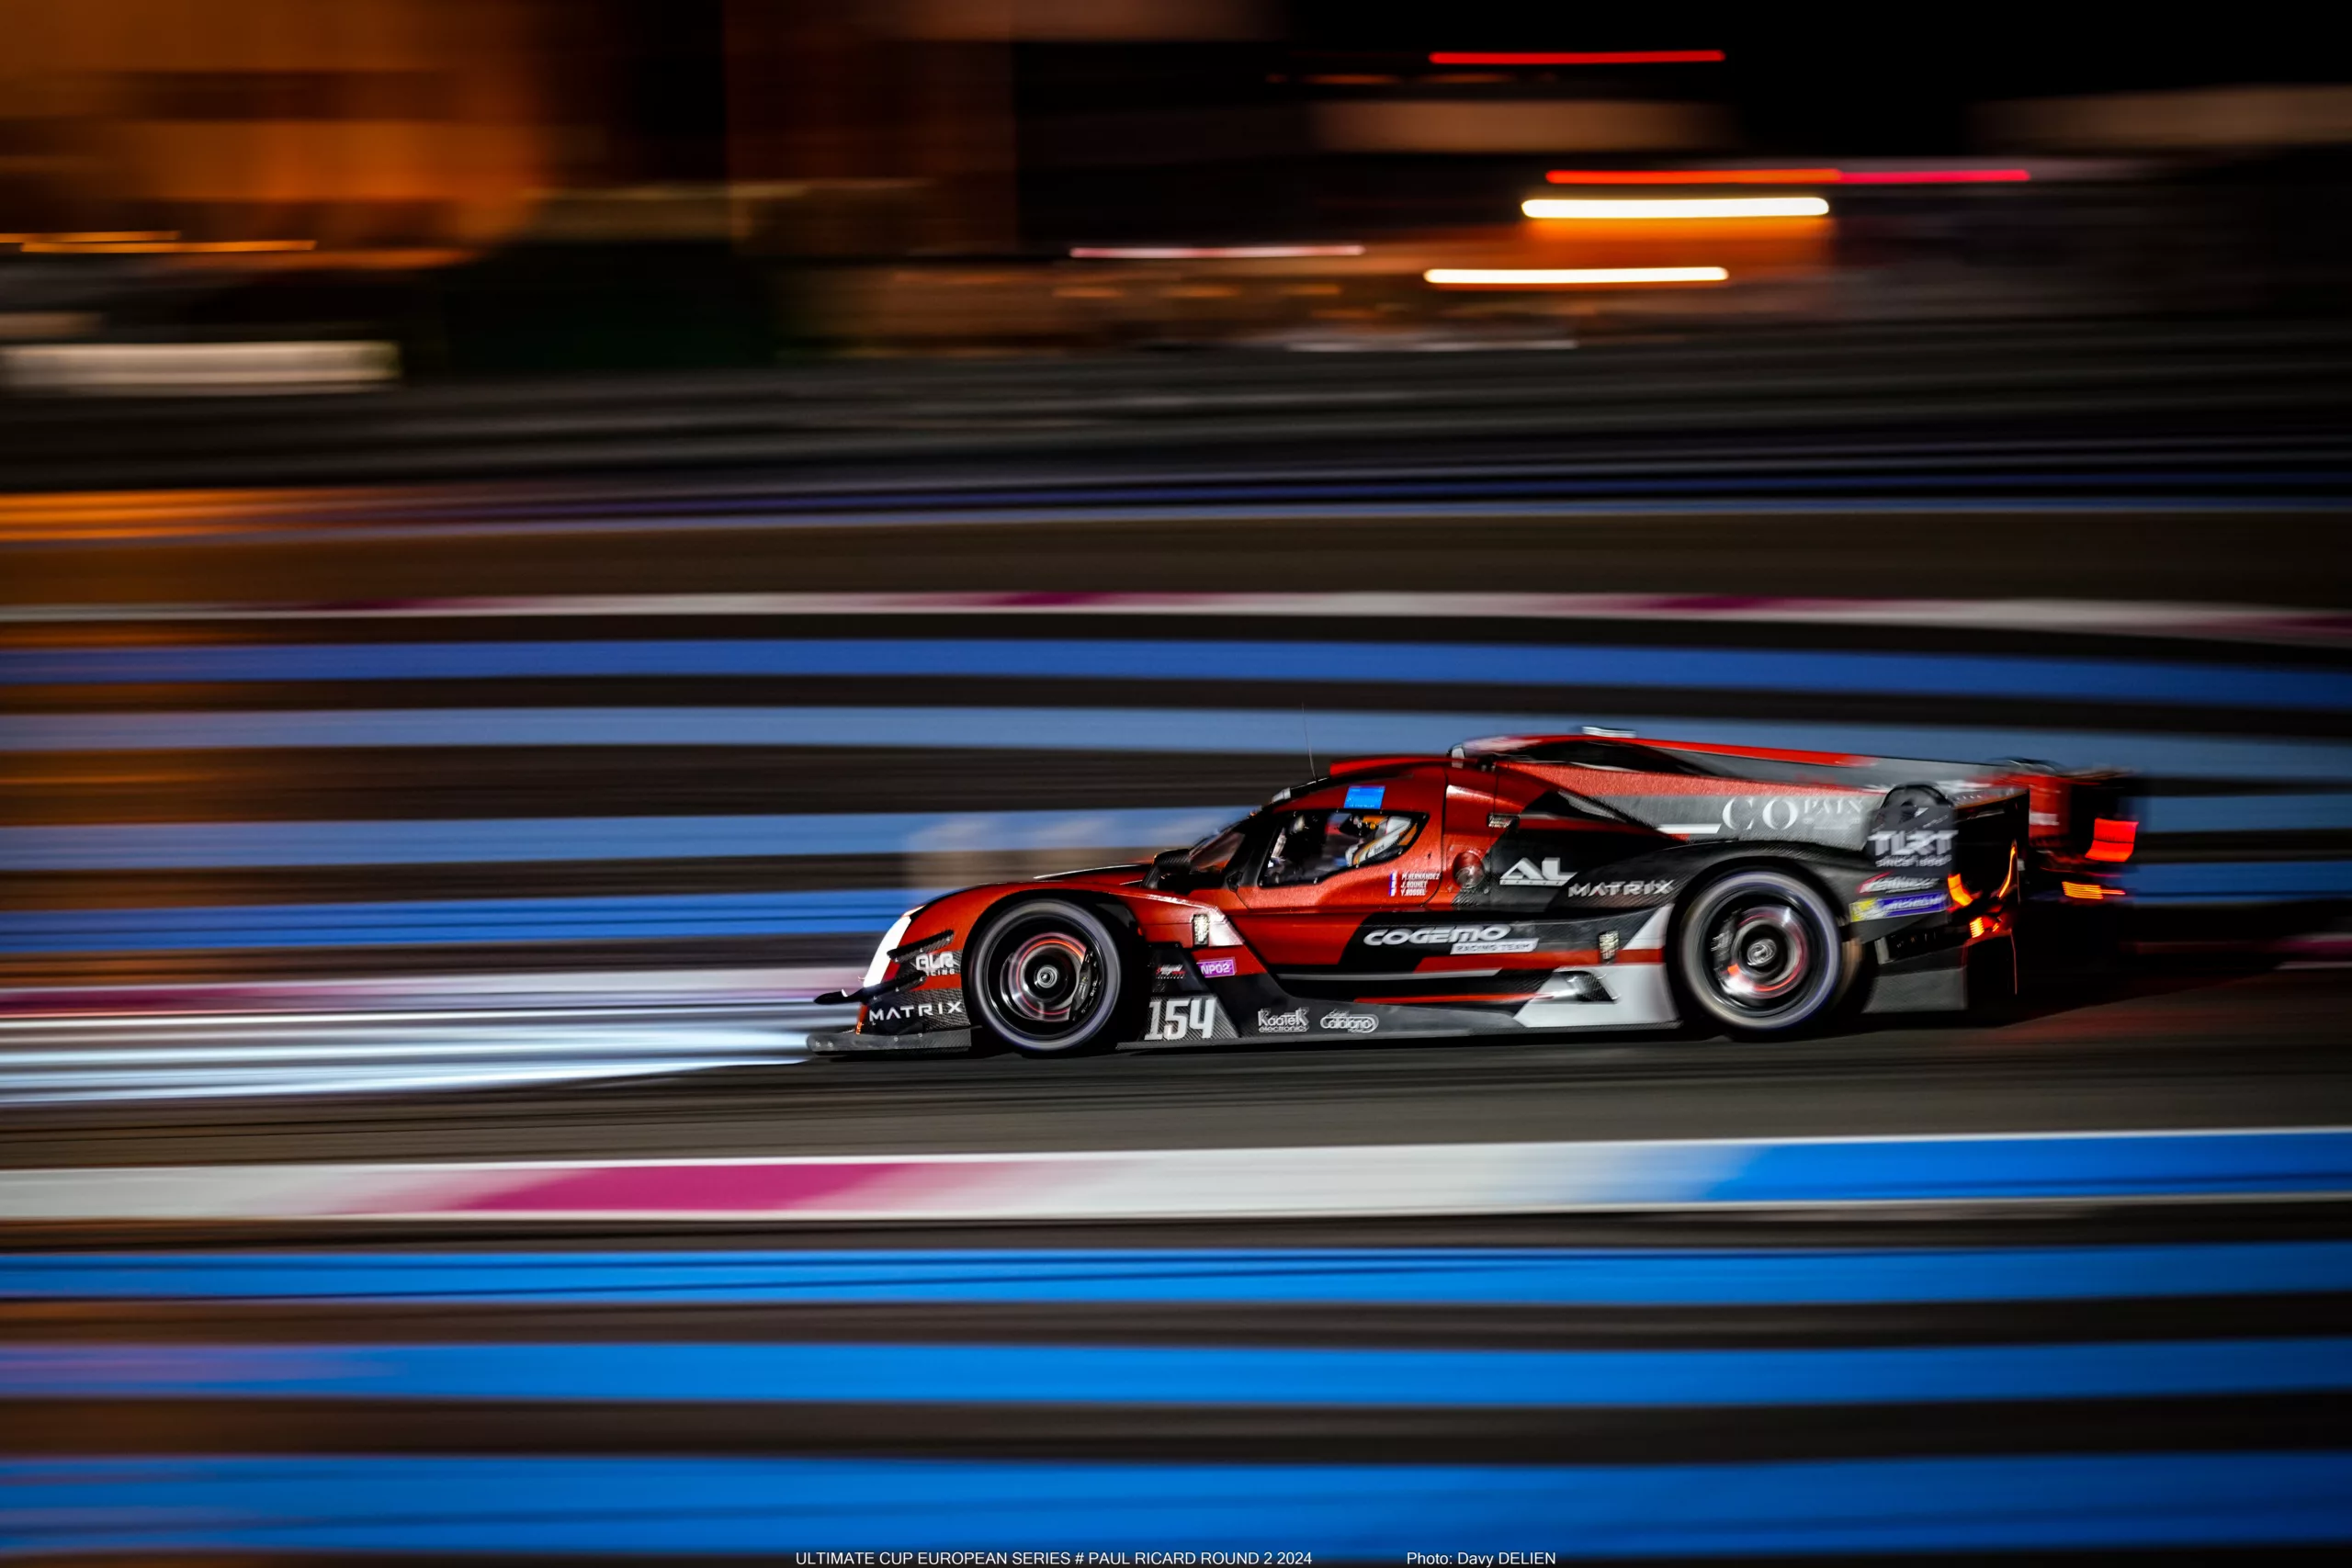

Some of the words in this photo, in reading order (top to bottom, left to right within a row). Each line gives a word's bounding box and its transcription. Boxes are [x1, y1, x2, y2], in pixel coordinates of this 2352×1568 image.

[1500, 857, 1577, 879] AL
[1567, 879, 1676, 897] MATRIX
[1363, 923, 1511, 946] COGEMO
[1200, 963, 1230, 974] NP02
[868, 1000, 963, 1021] MATRIX
[1144, 998, 1217, 1041] 154
